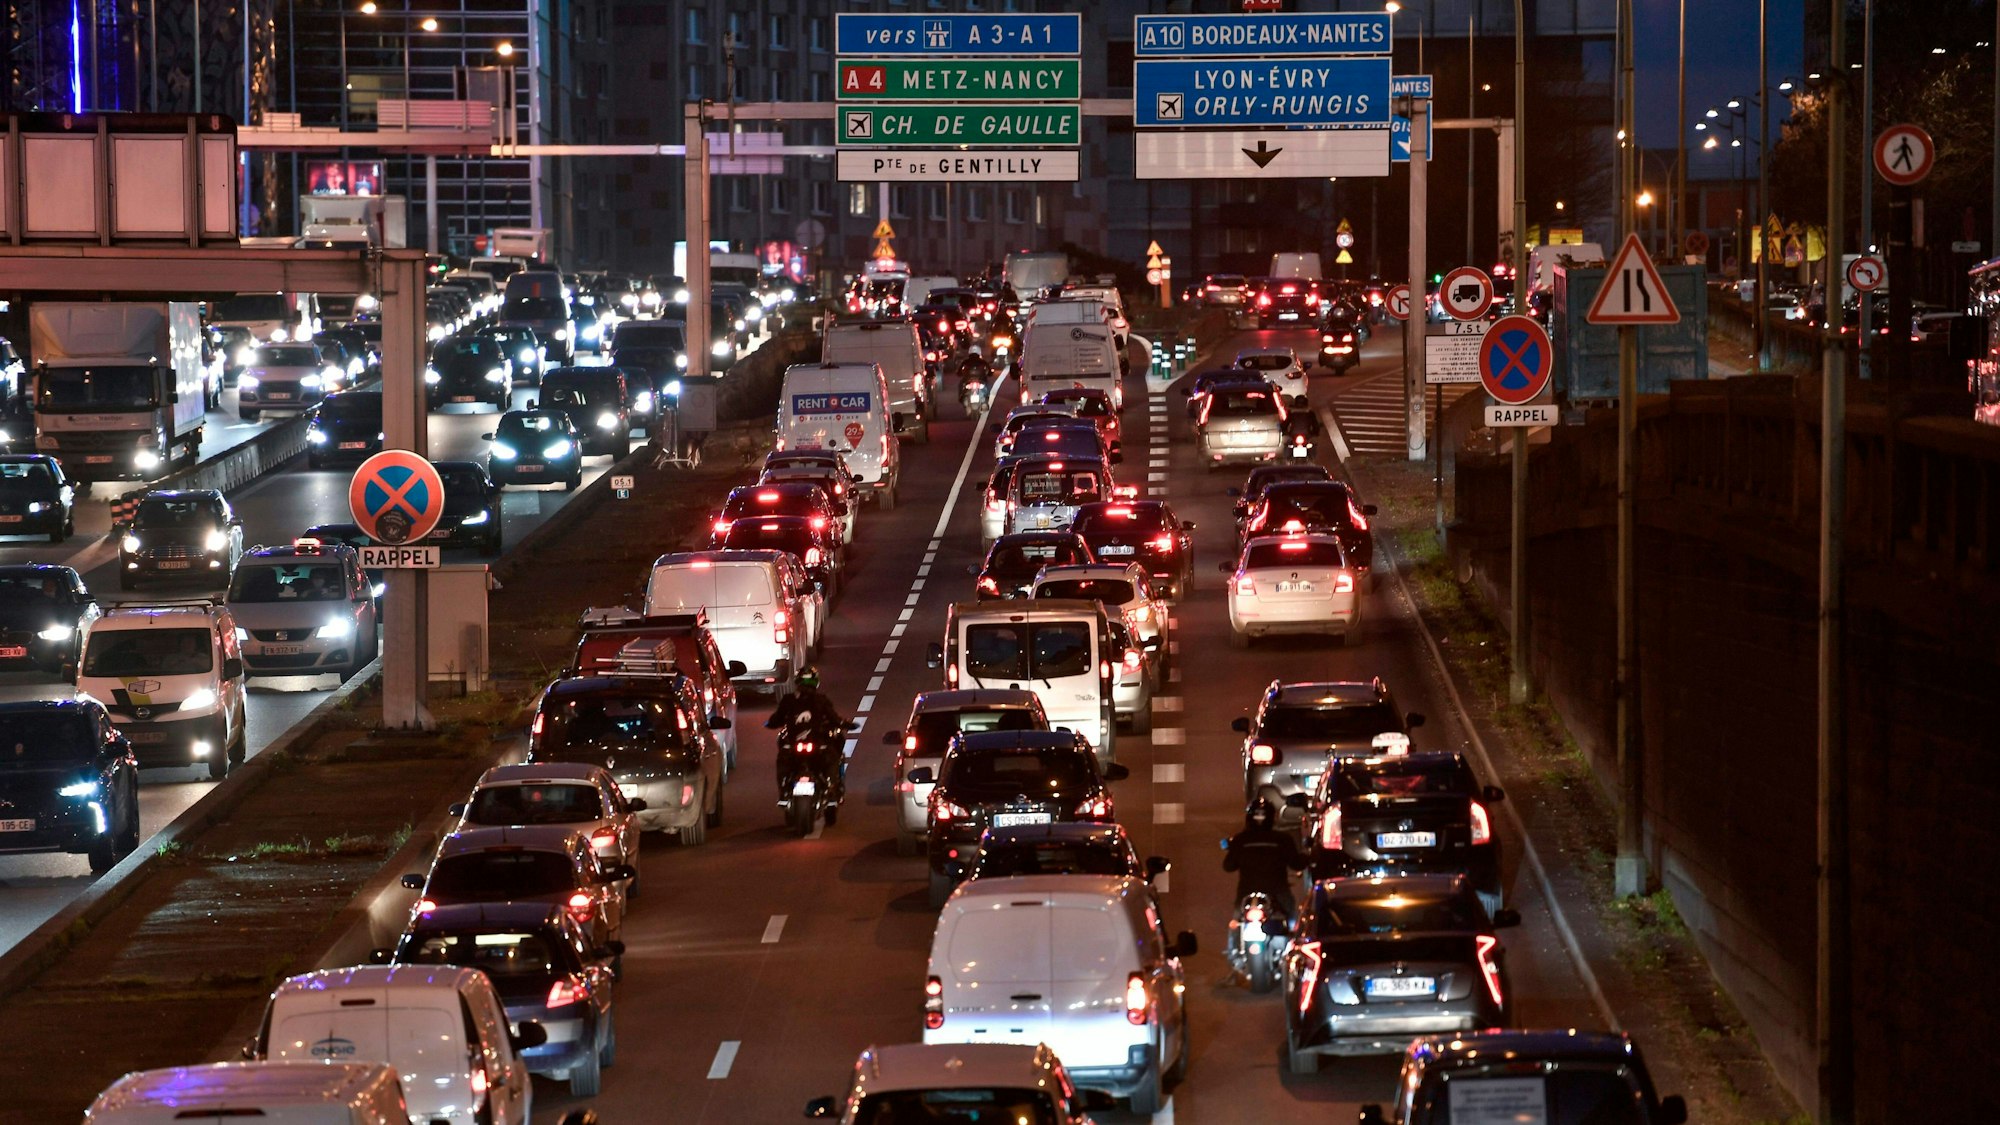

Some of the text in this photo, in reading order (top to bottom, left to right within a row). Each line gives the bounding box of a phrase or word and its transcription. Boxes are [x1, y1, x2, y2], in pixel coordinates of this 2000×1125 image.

[866, 29, 916, 44] vers
[1192, 23, 1384, 45] BORDEAUX-NANTES
[903, 70, 1064, 90] METZ-NANCY
[1194, 66, 1331, 90] LYON-ÉVRY
[1194, 94, 1370, 116] ORLY-RUNGIS
[881, 115, 1072, 135] CH. DE GAULLE
[910, 164, 927, 174] DE
[939, 159, 1042, 173] GENTILLY
[1454, 323, 1473, 334] 7.5
[798, 398, 827, 409] RENT
[840, 397, 865, 408] CAR
[1494, 409, 1548, 422] RAPPEL
[364, 550, 434, 565] RAPPEL
